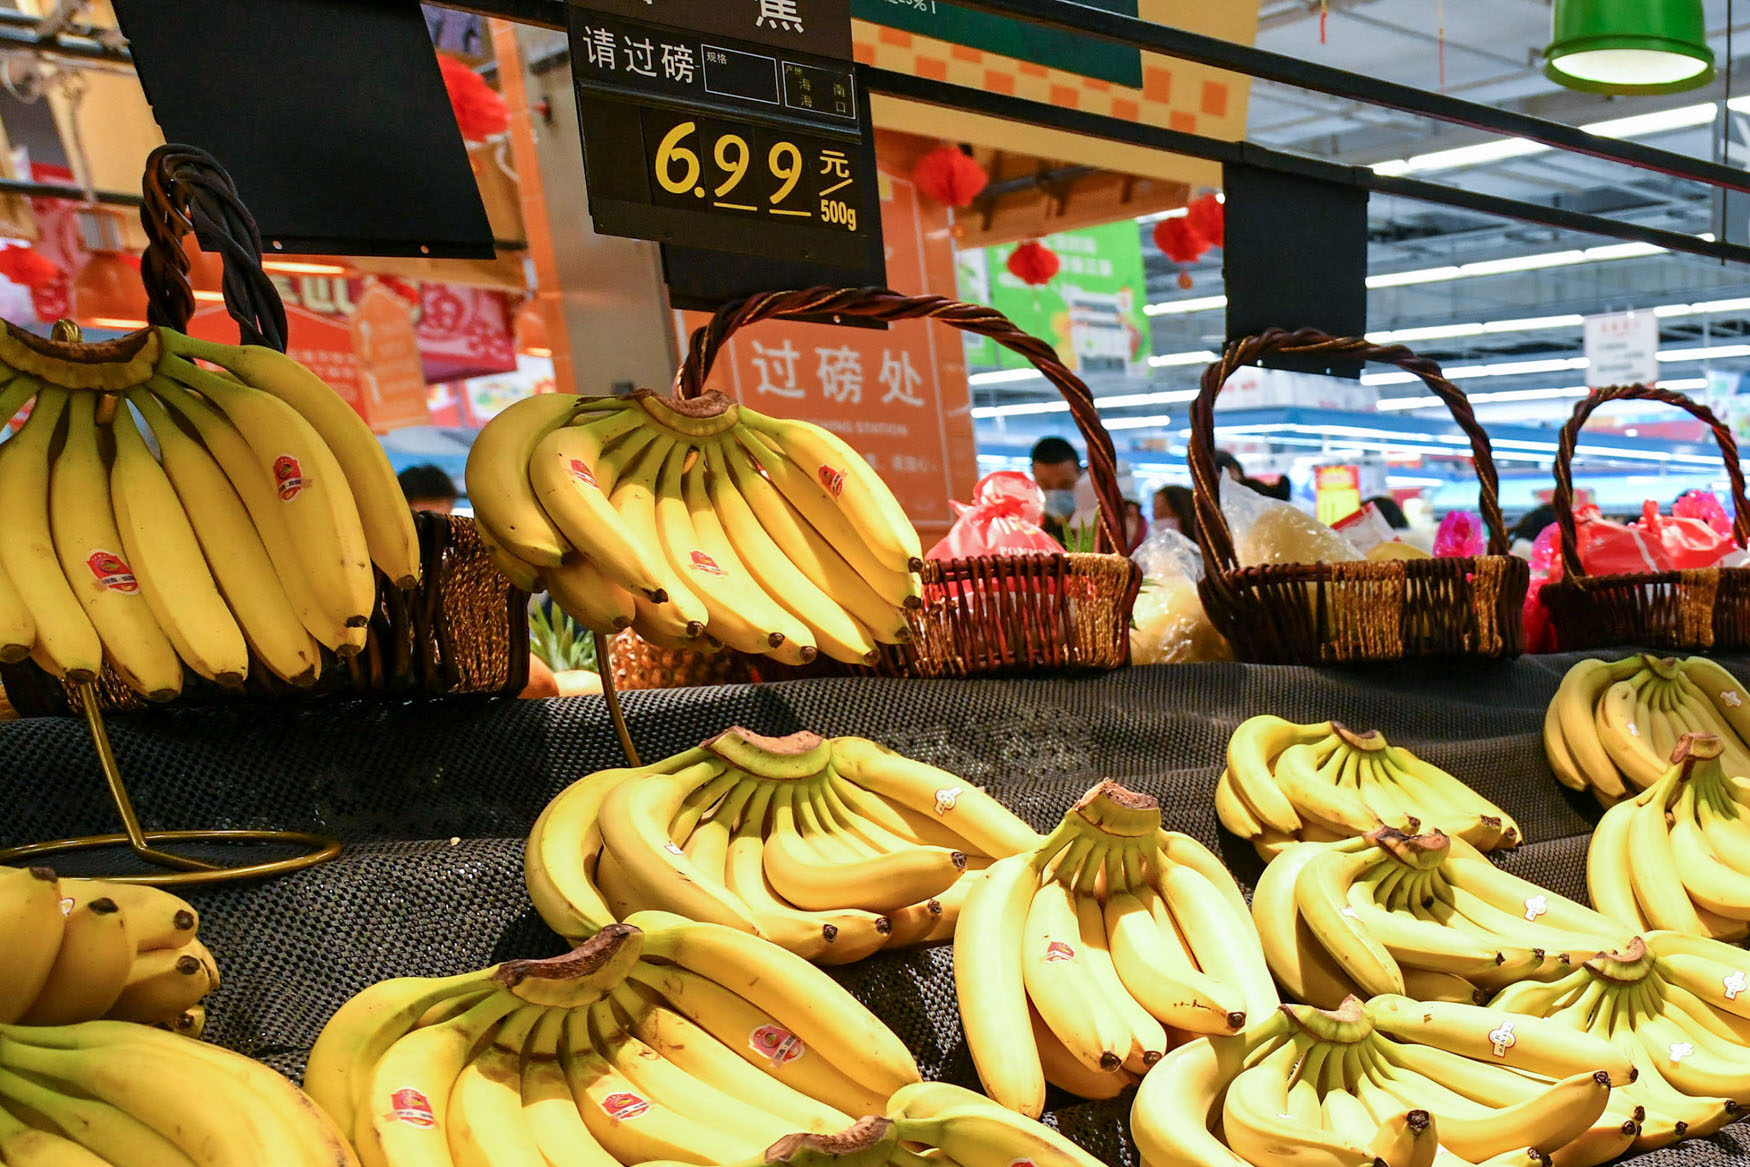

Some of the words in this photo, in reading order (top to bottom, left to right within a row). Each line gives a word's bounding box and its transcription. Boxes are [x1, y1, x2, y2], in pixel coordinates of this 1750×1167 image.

[582, 25, 696, 84] 请过磅
[706, 50, 728, 65] 规格
[655, 121, 804, 205] 6.99
[820, 199, 857, 231] 500g
[752, 339, 926, 407] 过磅处
